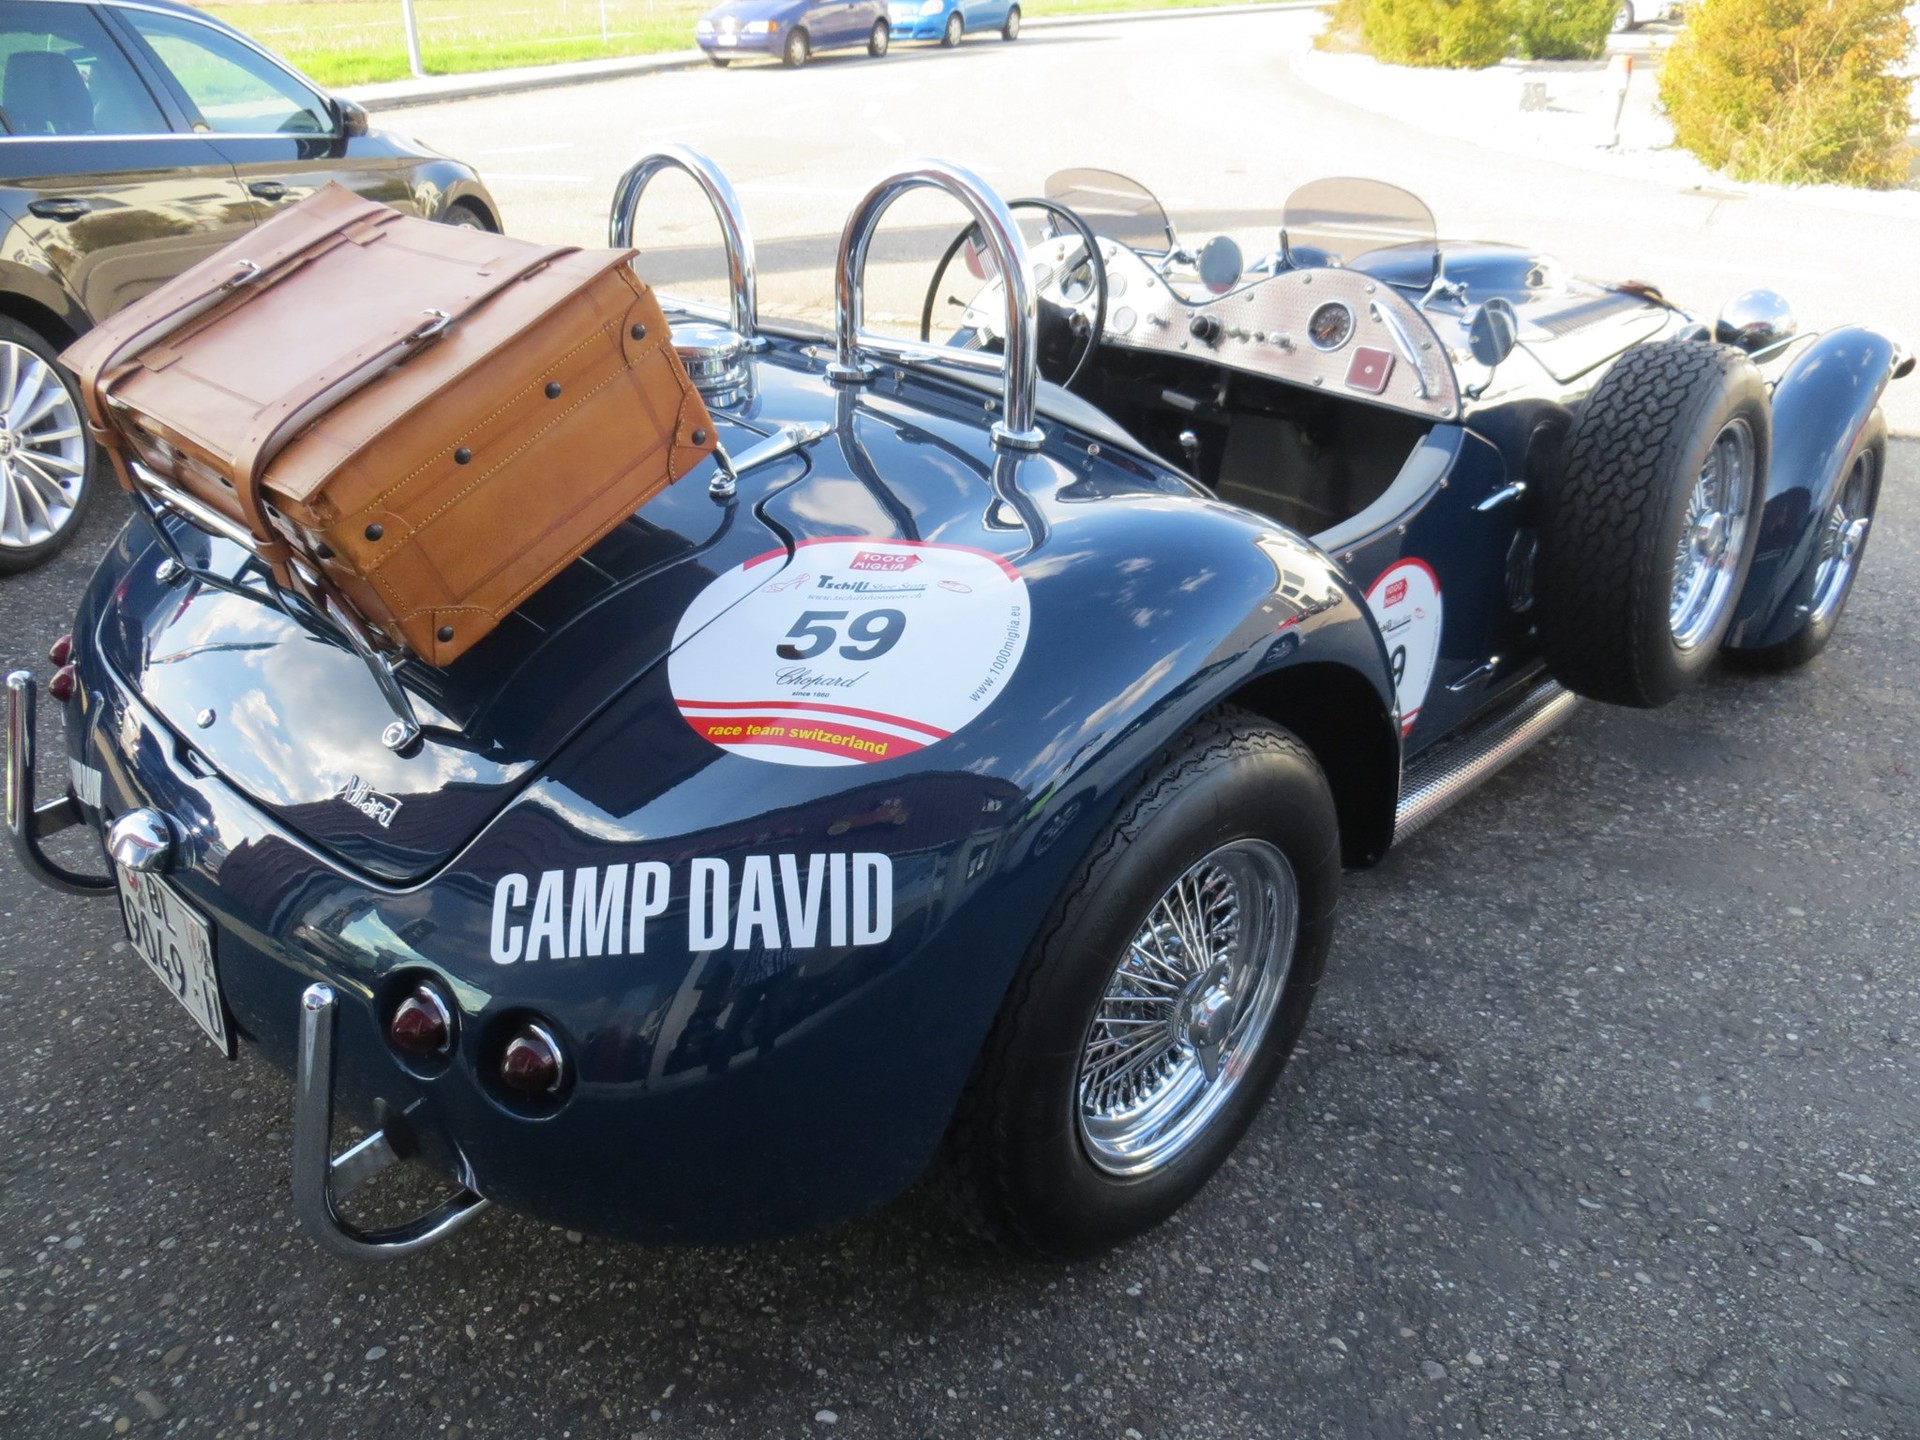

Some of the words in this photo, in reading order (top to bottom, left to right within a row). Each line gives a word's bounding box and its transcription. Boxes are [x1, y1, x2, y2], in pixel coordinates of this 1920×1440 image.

[852, 561, 905, 571] MIGLIA
[863, 553, 907, 563] 1000
[776, 608, 907, 661] 59
[969, 605, 1021, 702] www.1000miglia.eu
[775, 666, 870, 690] Chopard
[708, 724, 742, 736] race
[746, 724, 785, 737] team
[789, 727, 888, 756] switzerland
[146, 872, 177, 938] BL
[490, 860, 671, 965] CAMP
[688, 852, 893, 952] DAVID
[126, 893, 187, 999] 9049
